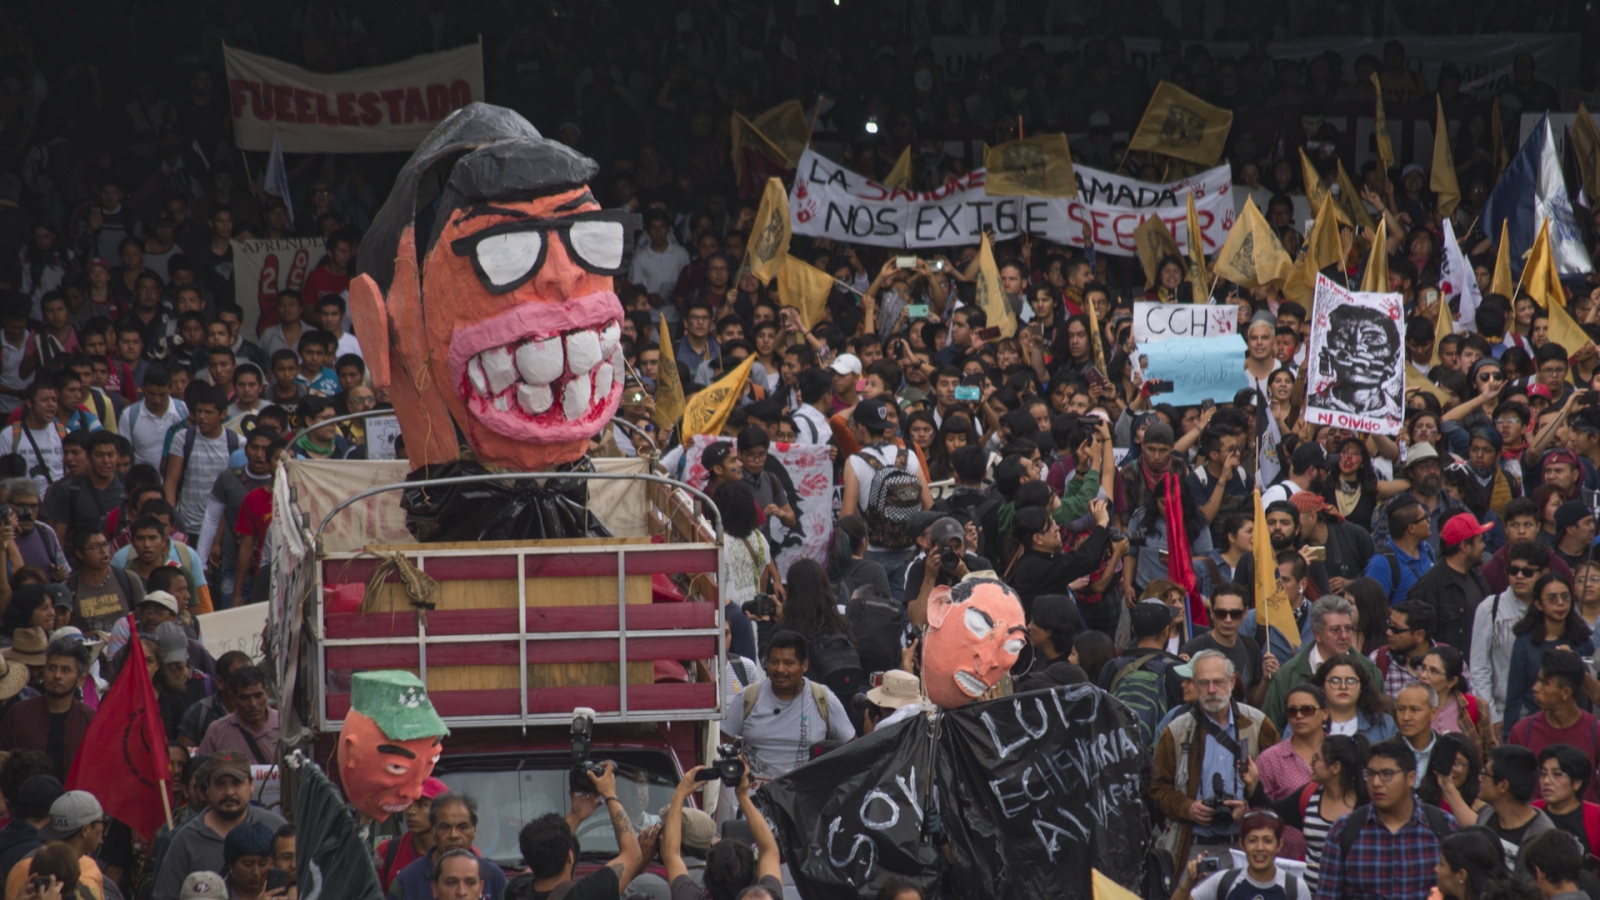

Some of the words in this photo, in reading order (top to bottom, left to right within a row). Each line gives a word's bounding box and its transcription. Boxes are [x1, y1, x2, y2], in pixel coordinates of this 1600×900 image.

[809, 159, 852, 192] LA
[1074, 172, 1178, 208] AMADA
[825, 202, 898, 237] NOS
[916, 200, 1048, 241] EXIGE
[1067, 203, 1216, 251] SEGIR
[263, 267, 276, 295] 2
[1146, 306, 1208, 336] CCH
[980, 684, 1102, 759] LUIS
[827, 765, 924, 881] SOY
